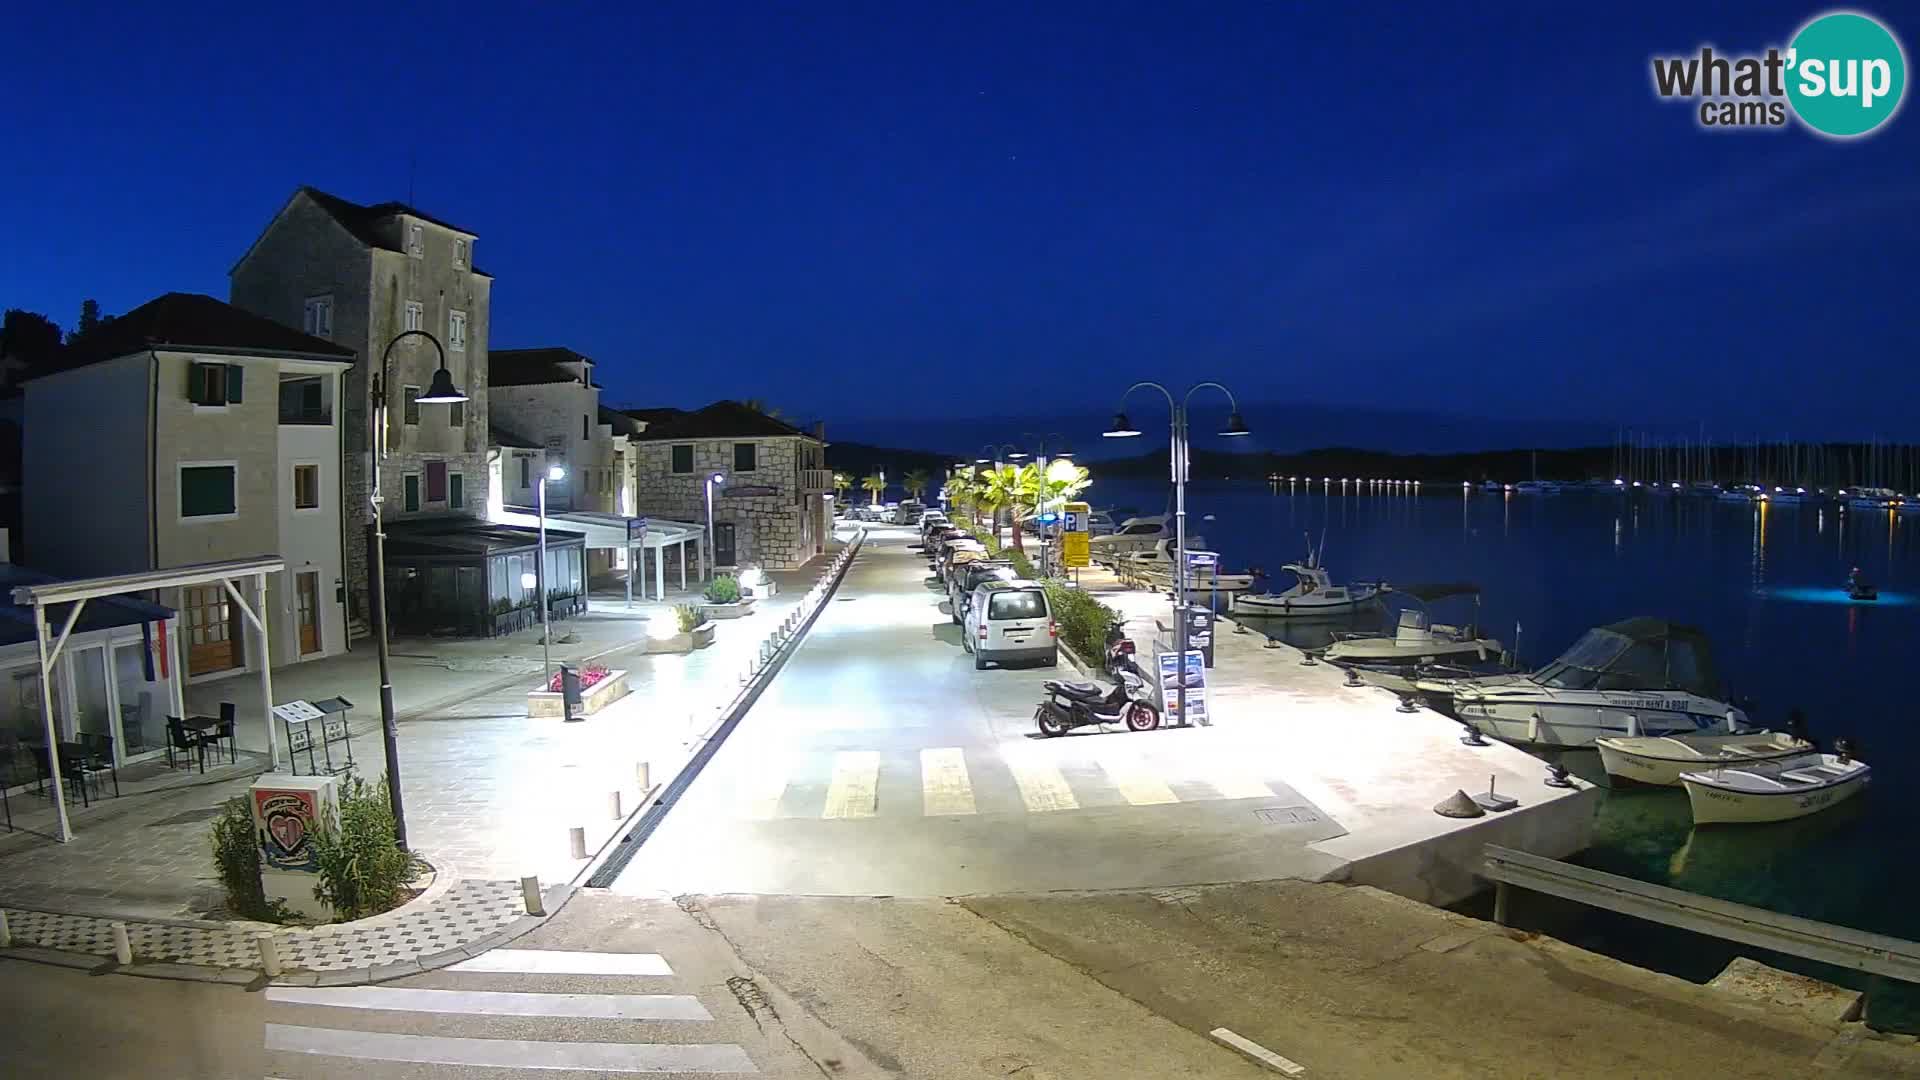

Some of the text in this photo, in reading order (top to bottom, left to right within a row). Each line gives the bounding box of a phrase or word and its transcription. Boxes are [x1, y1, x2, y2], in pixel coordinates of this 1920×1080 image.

[1065, 514, 1076, 531] P
[1645, 699, 1664, 710] RENT
[1671, 699, 1689, 712] BOAT
